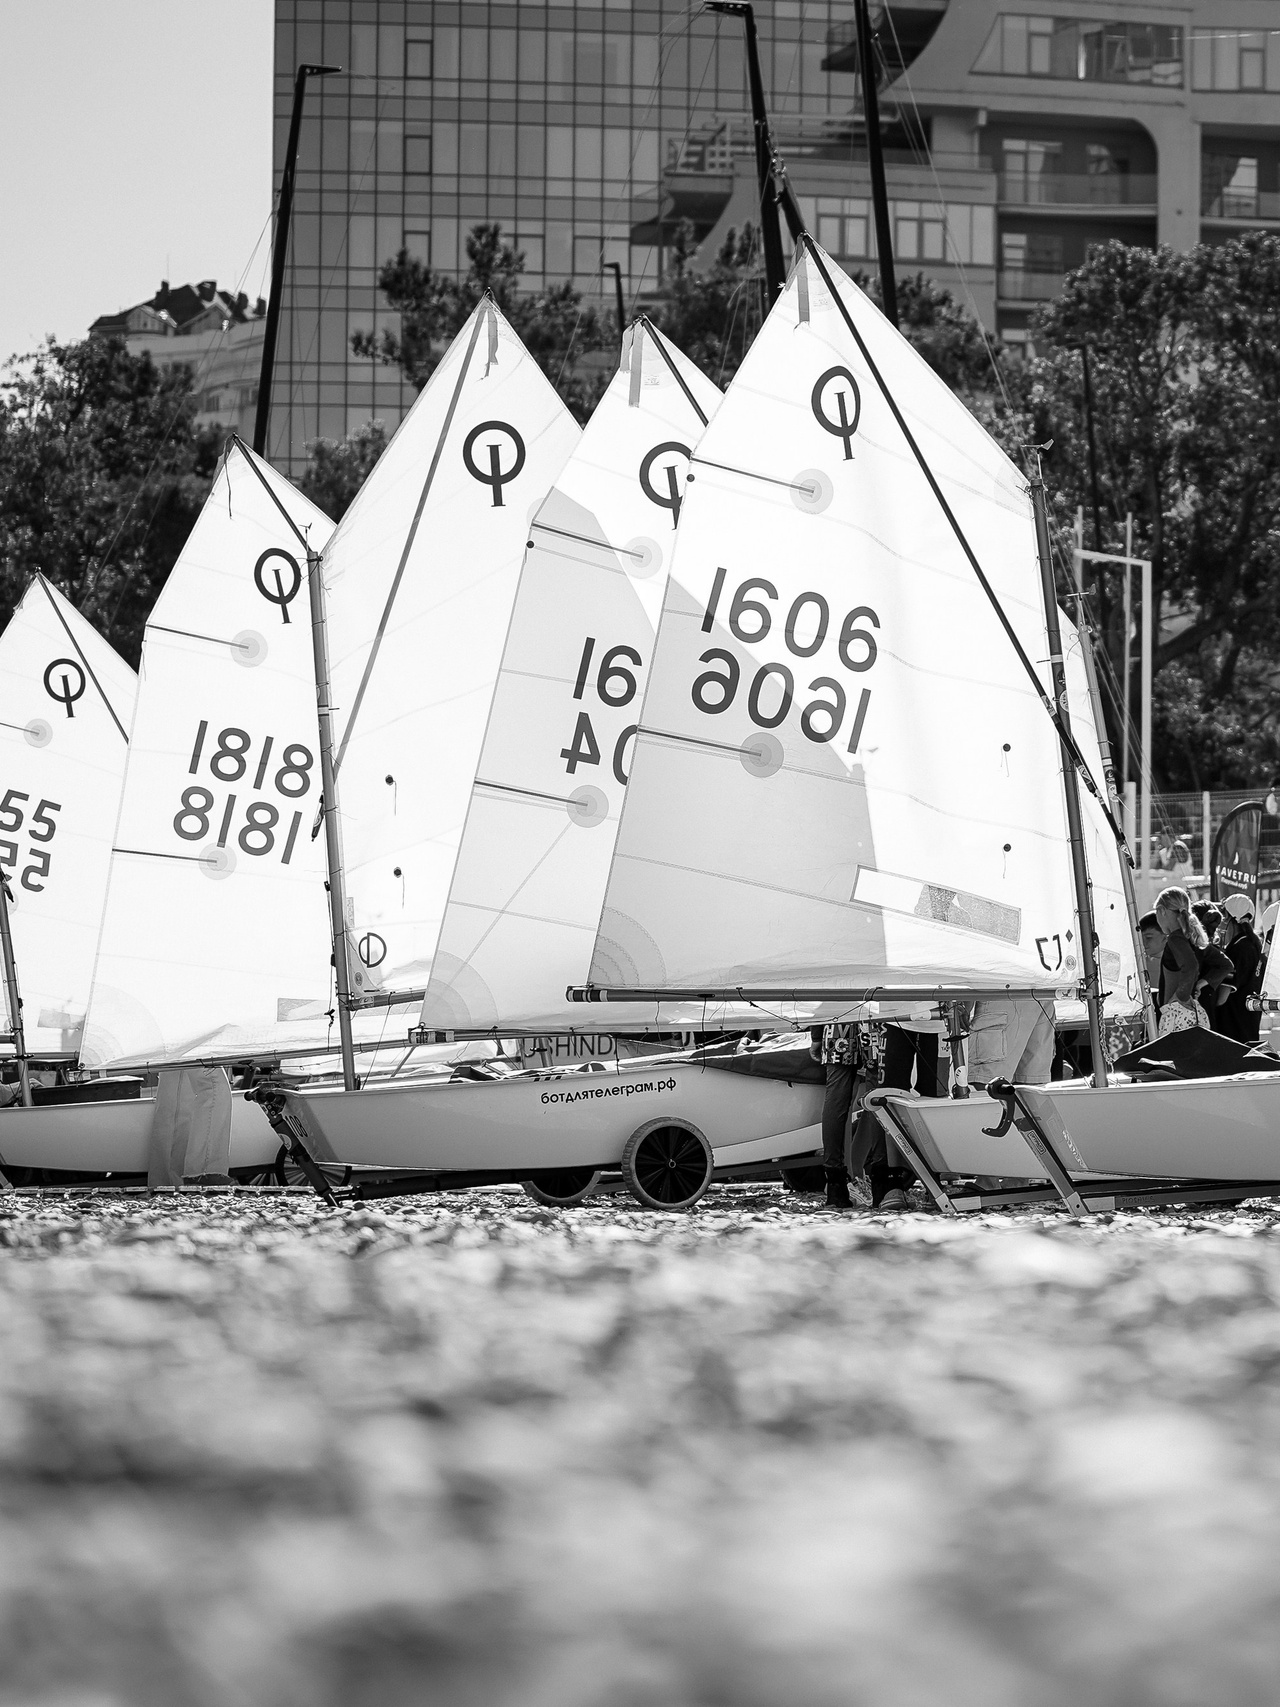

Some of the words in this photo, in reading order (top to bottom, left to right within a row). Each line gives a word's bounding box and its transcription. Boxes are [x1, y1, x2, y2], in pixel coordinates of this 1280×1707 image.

[701, 567, 881, 672] 1606
[188, 719, 314, 798] 1818
[0, 789, 62, 842] 55
[541, 1077, 677, 1104] ботдлятелеграм.рф
